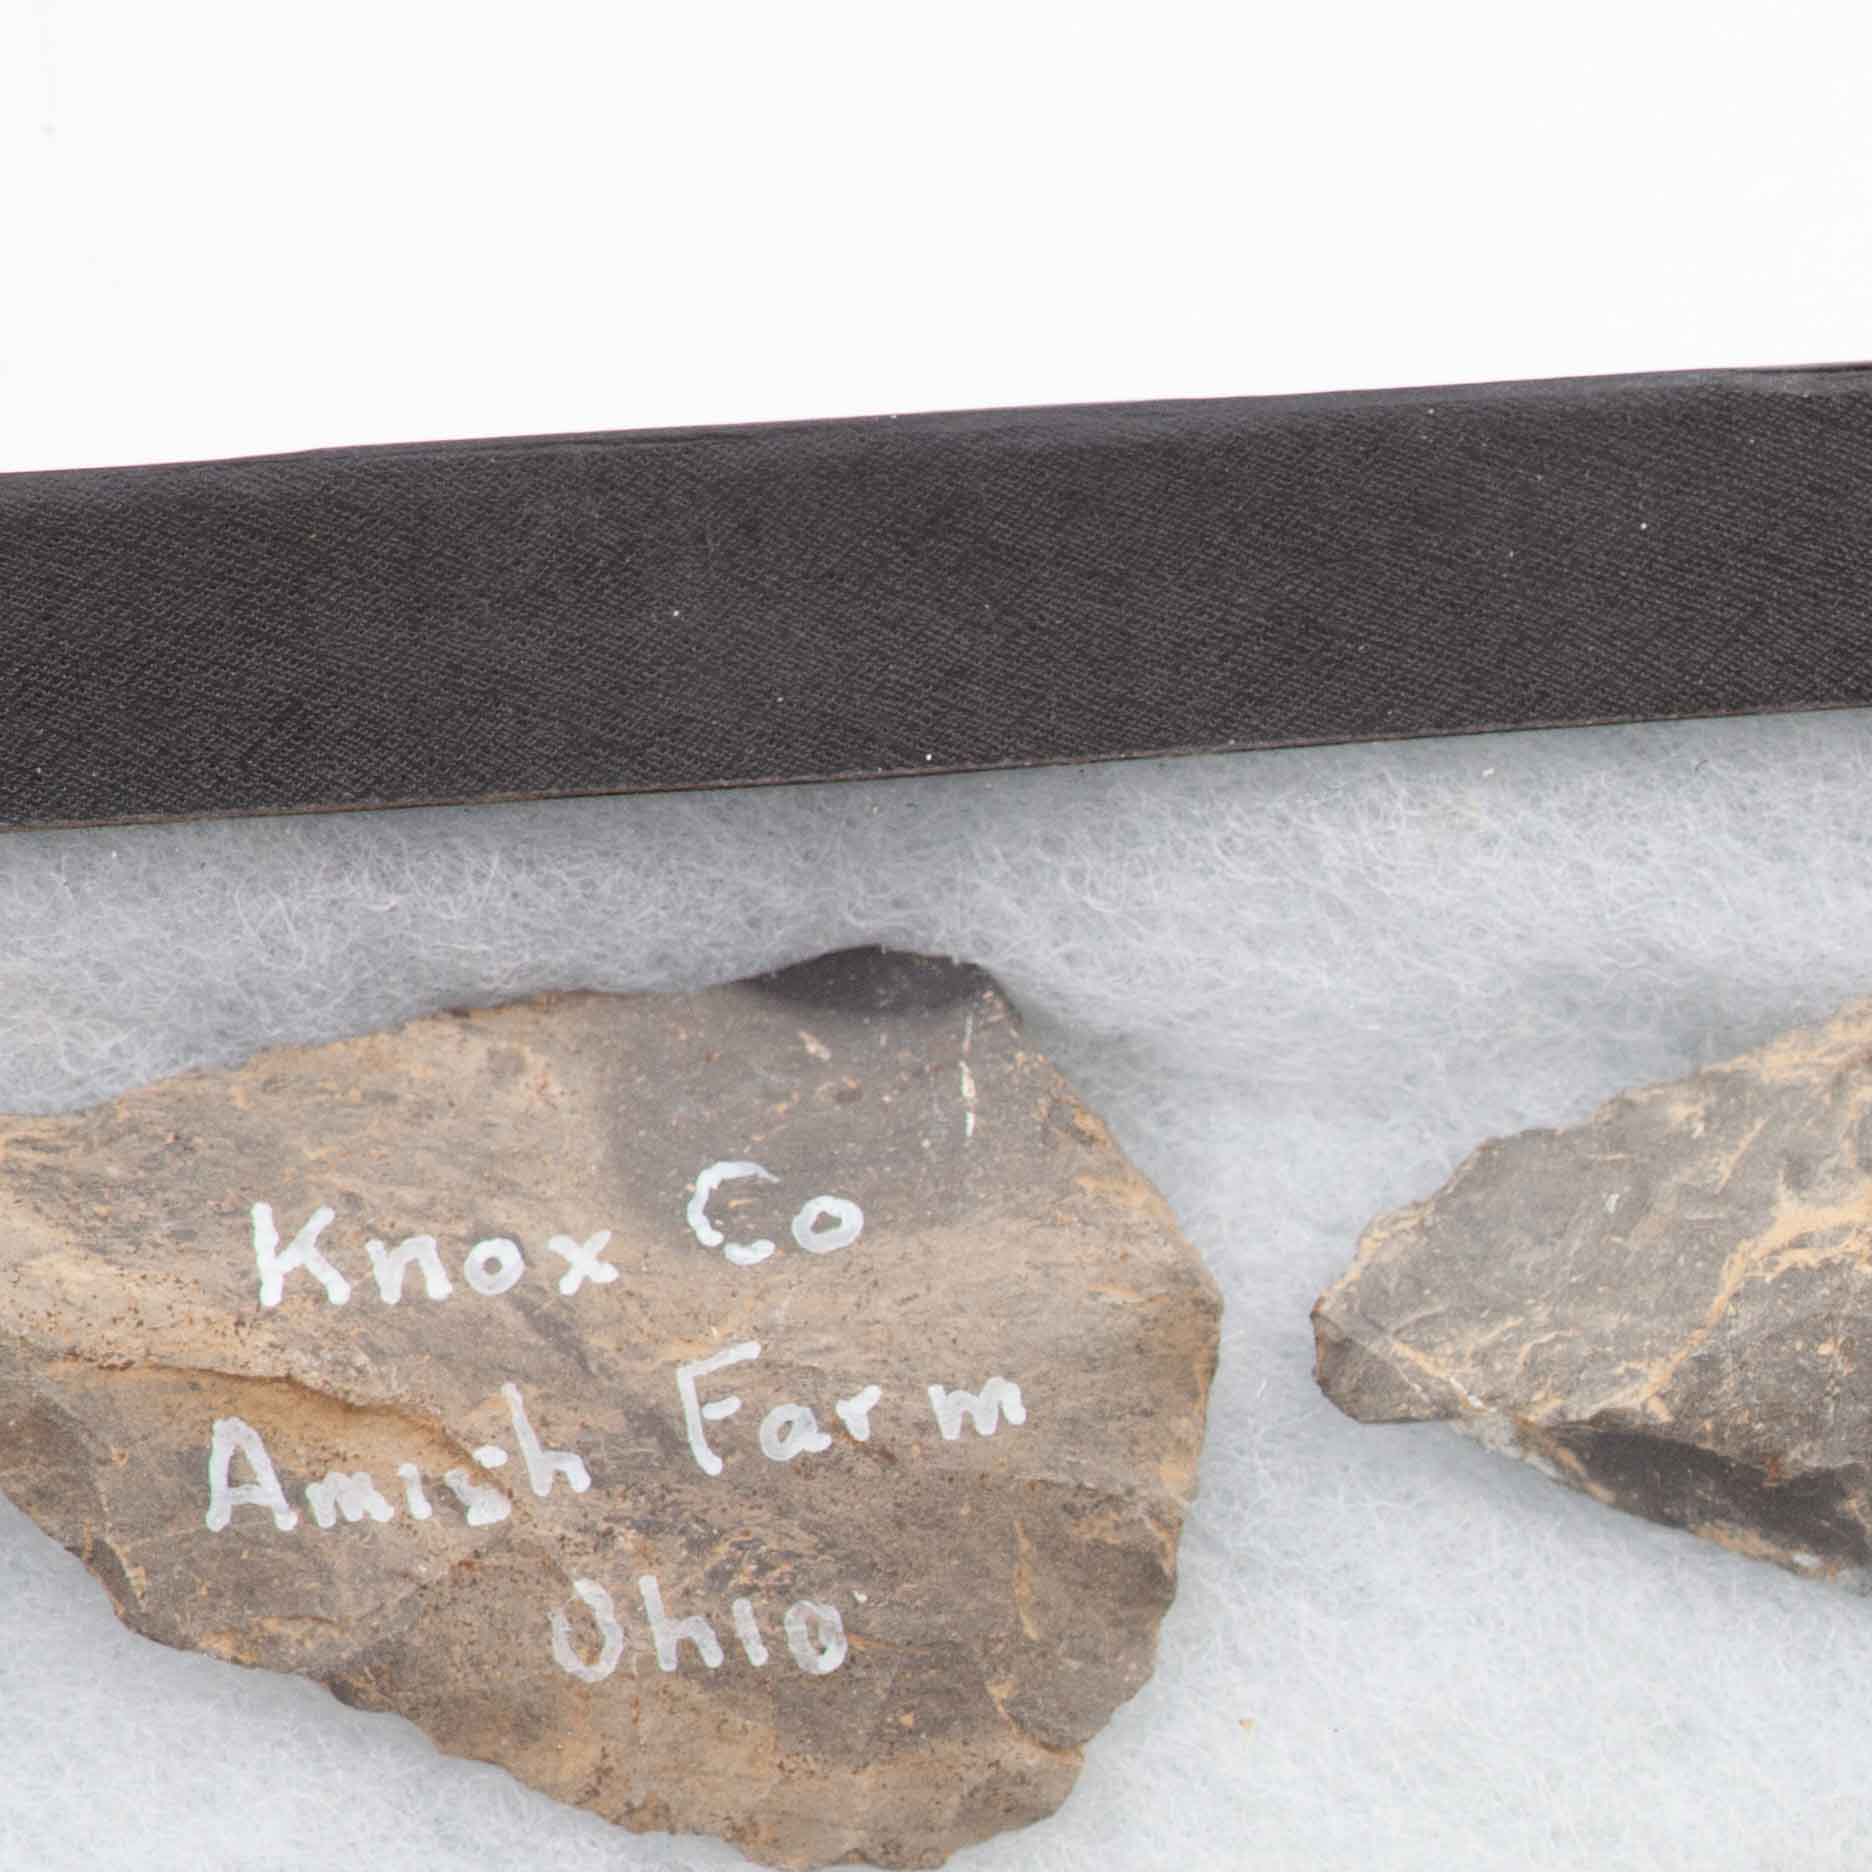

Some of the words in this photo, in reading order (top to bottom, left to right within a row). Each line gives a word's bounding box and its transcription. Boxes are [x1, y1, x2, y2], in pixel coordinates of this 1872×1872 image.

[251, 1202, 617, 1306] Knox
[688, 1161, 864, 1266] Co
[206, 1385, 592, 1532] Amish
[676, 1341, 1027, 1476] Farm
[548, 1577, 847, 1683] Ohio
